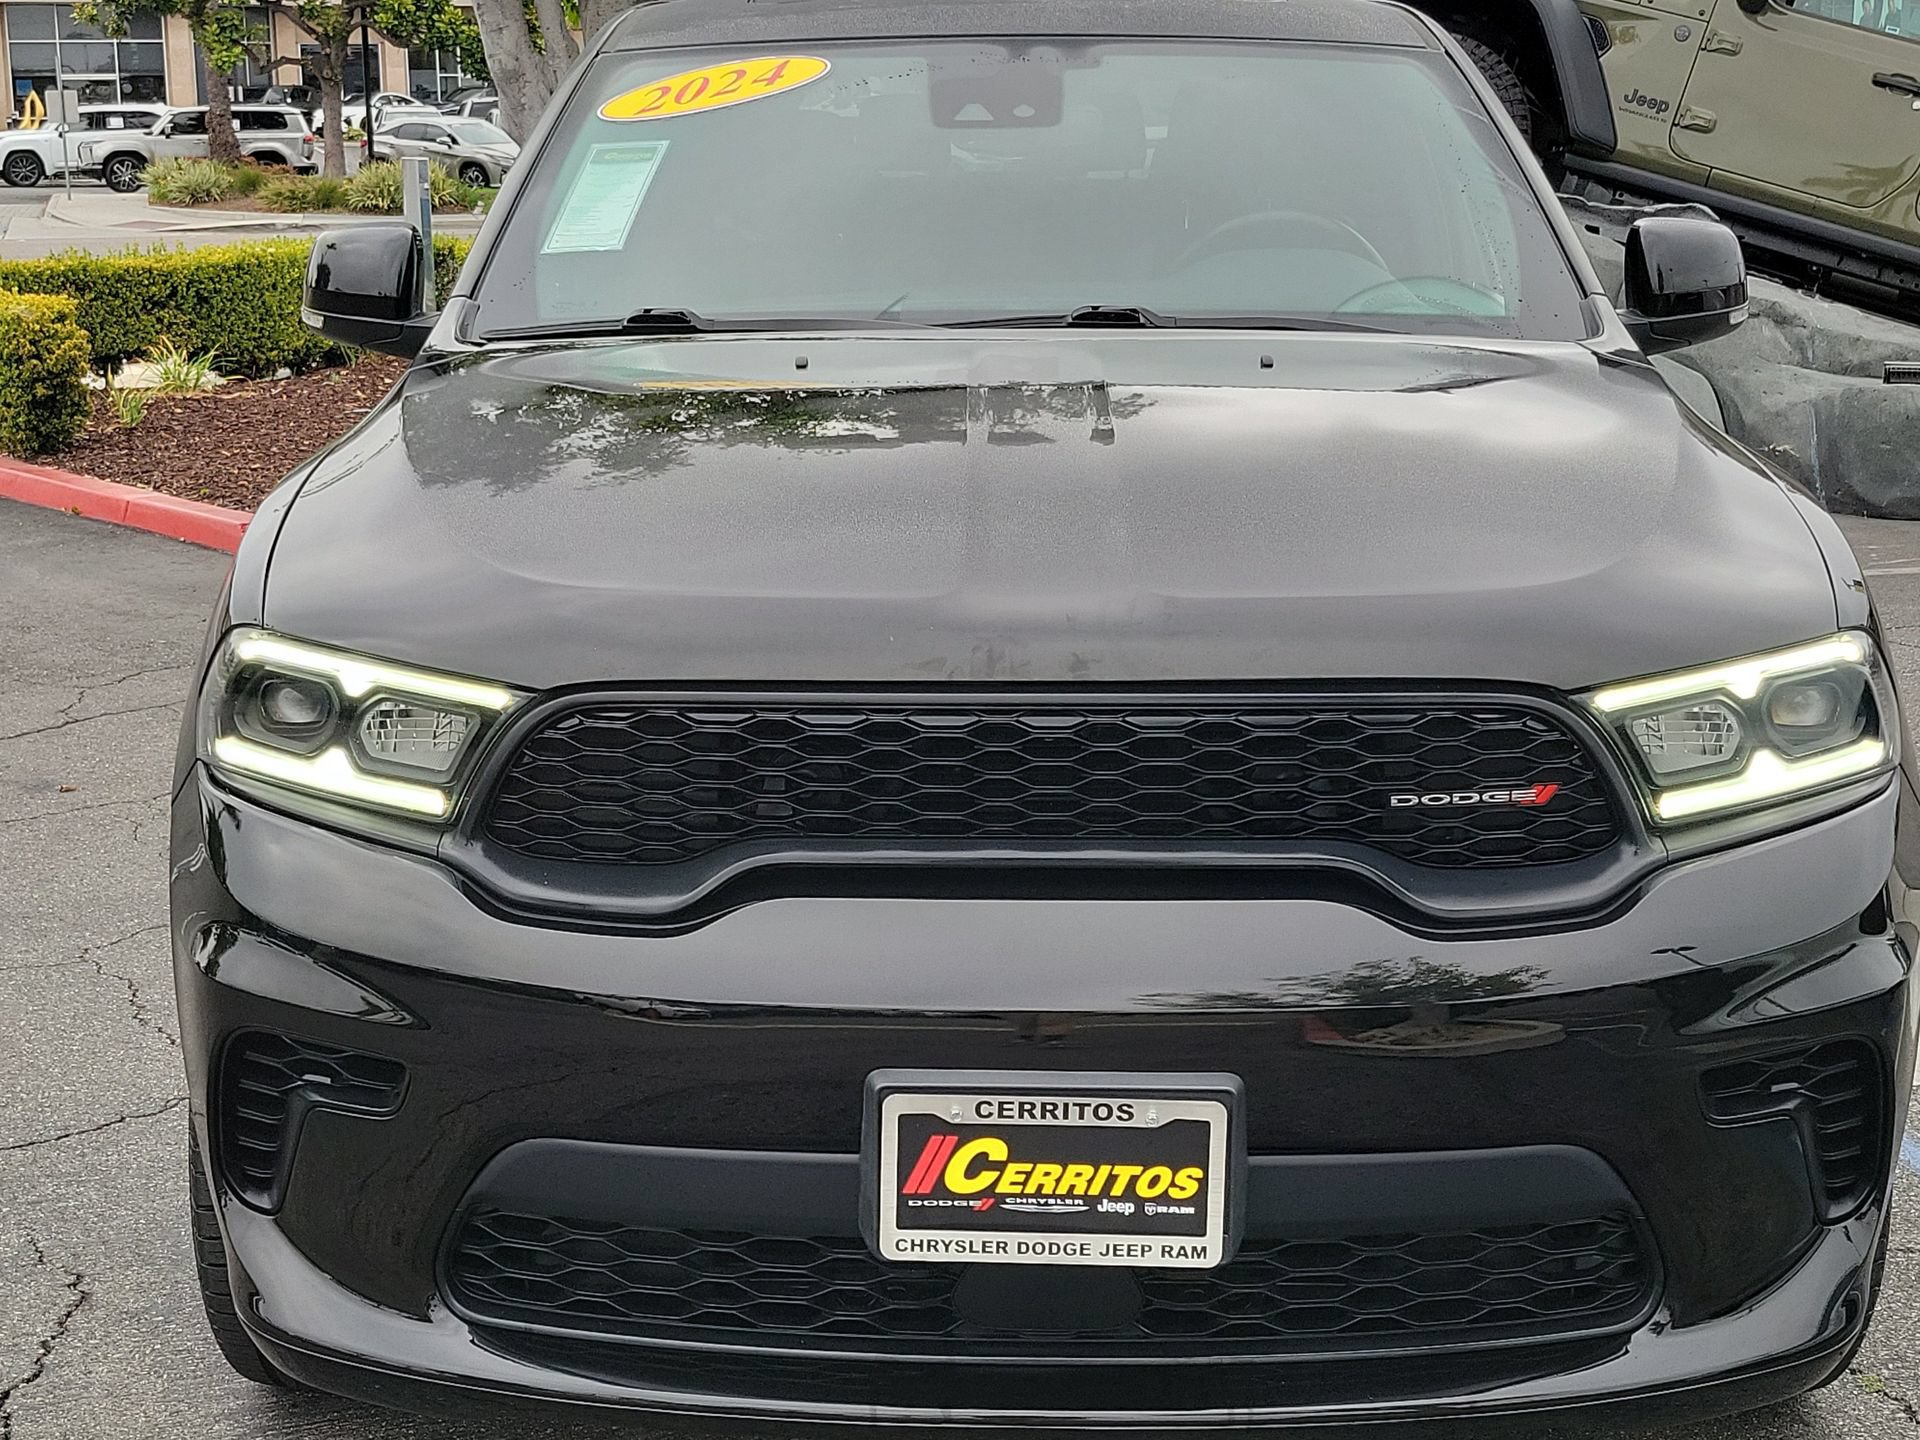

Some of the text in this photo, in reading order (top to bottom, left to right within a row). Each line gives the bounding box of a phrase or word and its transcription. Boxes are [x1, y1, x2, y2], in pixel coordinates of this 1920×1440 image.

[634, 60, 791, 116] 2024
[1623, 88, 1670, 115] Jeep
[1390, 789, 1538, 807] DODGE
[974, 1100, 1135, 1122] CERRITOS
[944, 1137, 1204, 1199] CERRITOS
[908, 1199, 983, 1207] DODGE
[1005, 1197, 1084, 1205] CHRYSLER
[1097, 1199, 1135, 1216] Jeep
[1157, 1205, 1195, 1214] RAM
[895, 1238, 1208, 1260] CHRYSLER DODGE JEEP RAM
